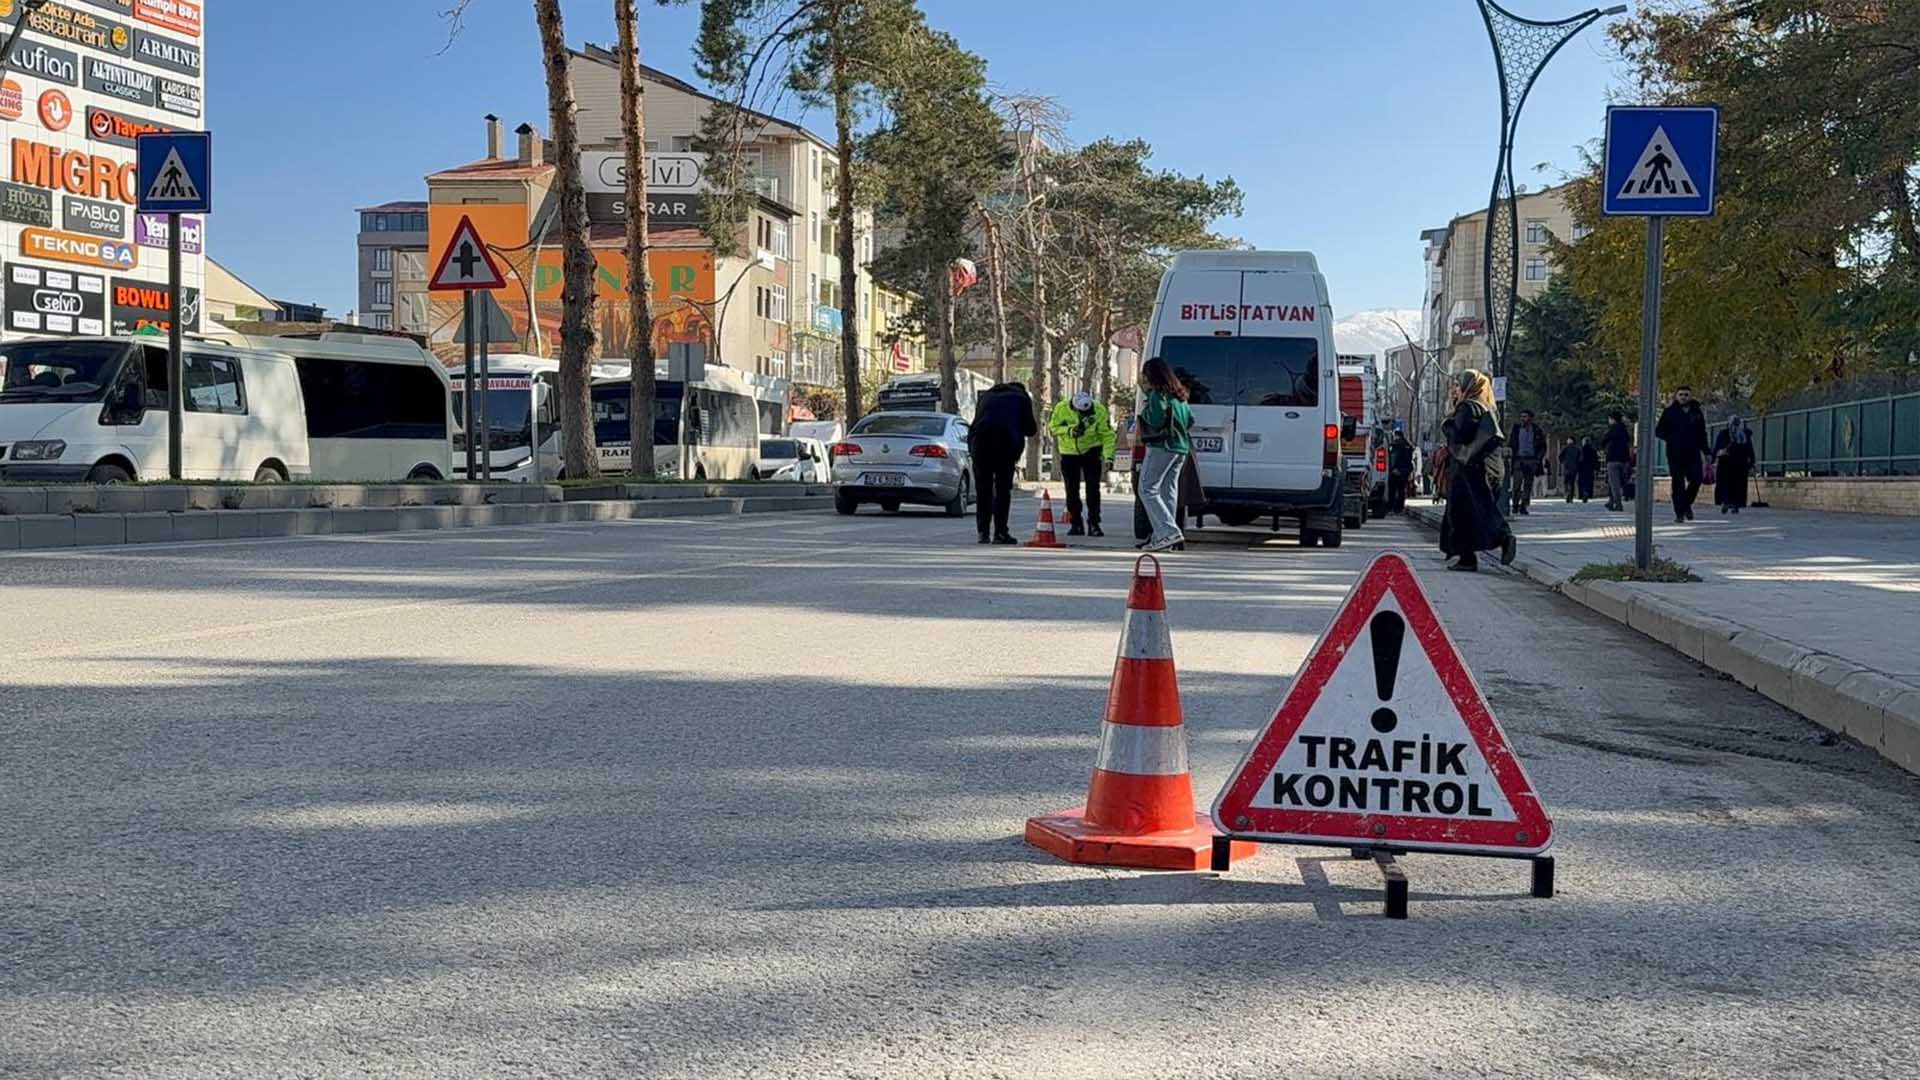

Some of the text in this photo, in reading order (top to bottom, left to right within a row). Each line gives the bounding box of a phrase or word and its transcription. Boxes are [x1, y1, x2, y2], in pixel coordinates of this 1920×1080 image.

[139, 38, 199, 67] ARMINE
[13, 138, 136, 204] MiGRO
[616, 159, 681, 185] slvi
[70, 202, 120, 222] PABLO
[612, 201, 687, 216] SRAR
[536, 264, 696, 292] PNR
[117, 286, 169, 310] BOWLI
[1242, 305, 1315, 322] TATVAN
[602, 449, 630, 458] RAH
[1299, 733, 1468, 776] TRAFİK
[1273, 772, 1493, 816] KONTROL
